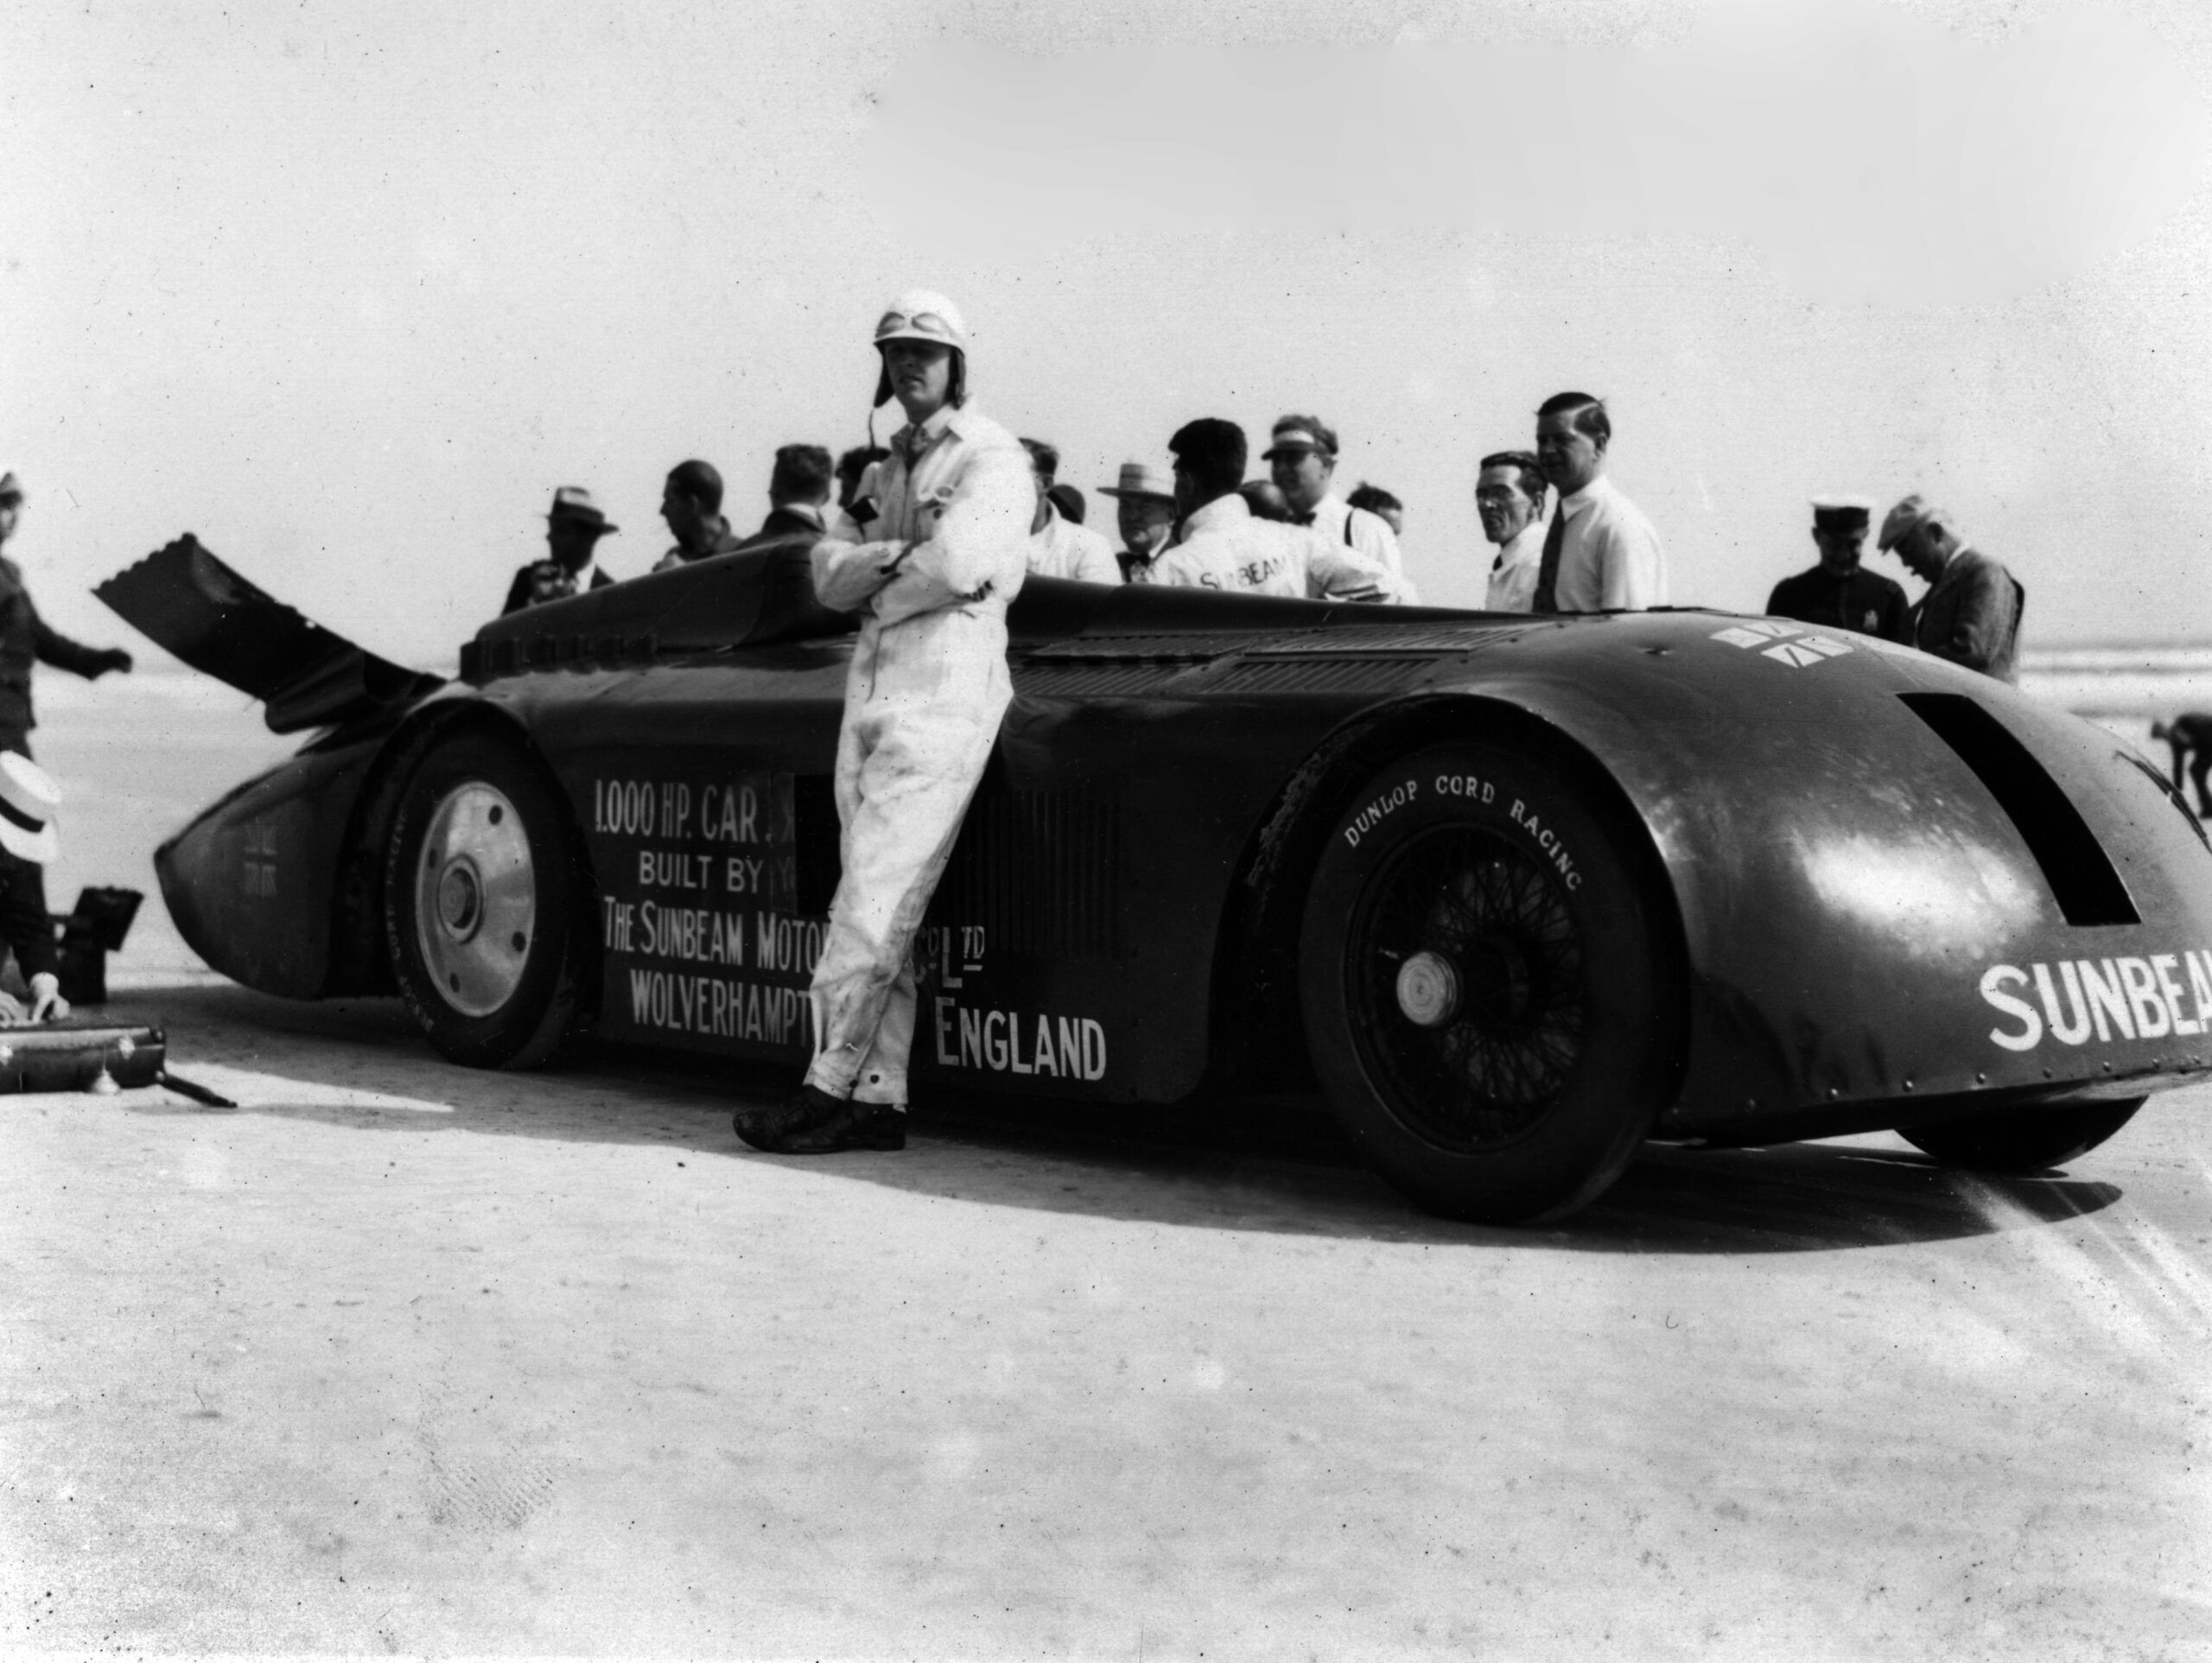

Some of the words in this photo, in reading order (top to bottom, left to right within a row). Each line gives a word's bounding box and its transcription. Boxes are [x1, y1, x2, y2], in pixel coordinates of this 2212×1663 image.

[1344, 780, 1418, 847] DUNLOP
[1435, 776, 1495, 803] CORD
[639, 850, 713, 890] BUILT
[727, 858, 764, 893] BY
[604, 896, 635, 952] THE
[640, 899, 743, 966] SUNBEAM
[757, 911, 830, 975] MOTO
[630, 968, 814, 1048] WOLVERHAMPT
[936, 996, 1106, 1081] ENGLAND
[1980, 950, 2212, 1051] SUNBEA
